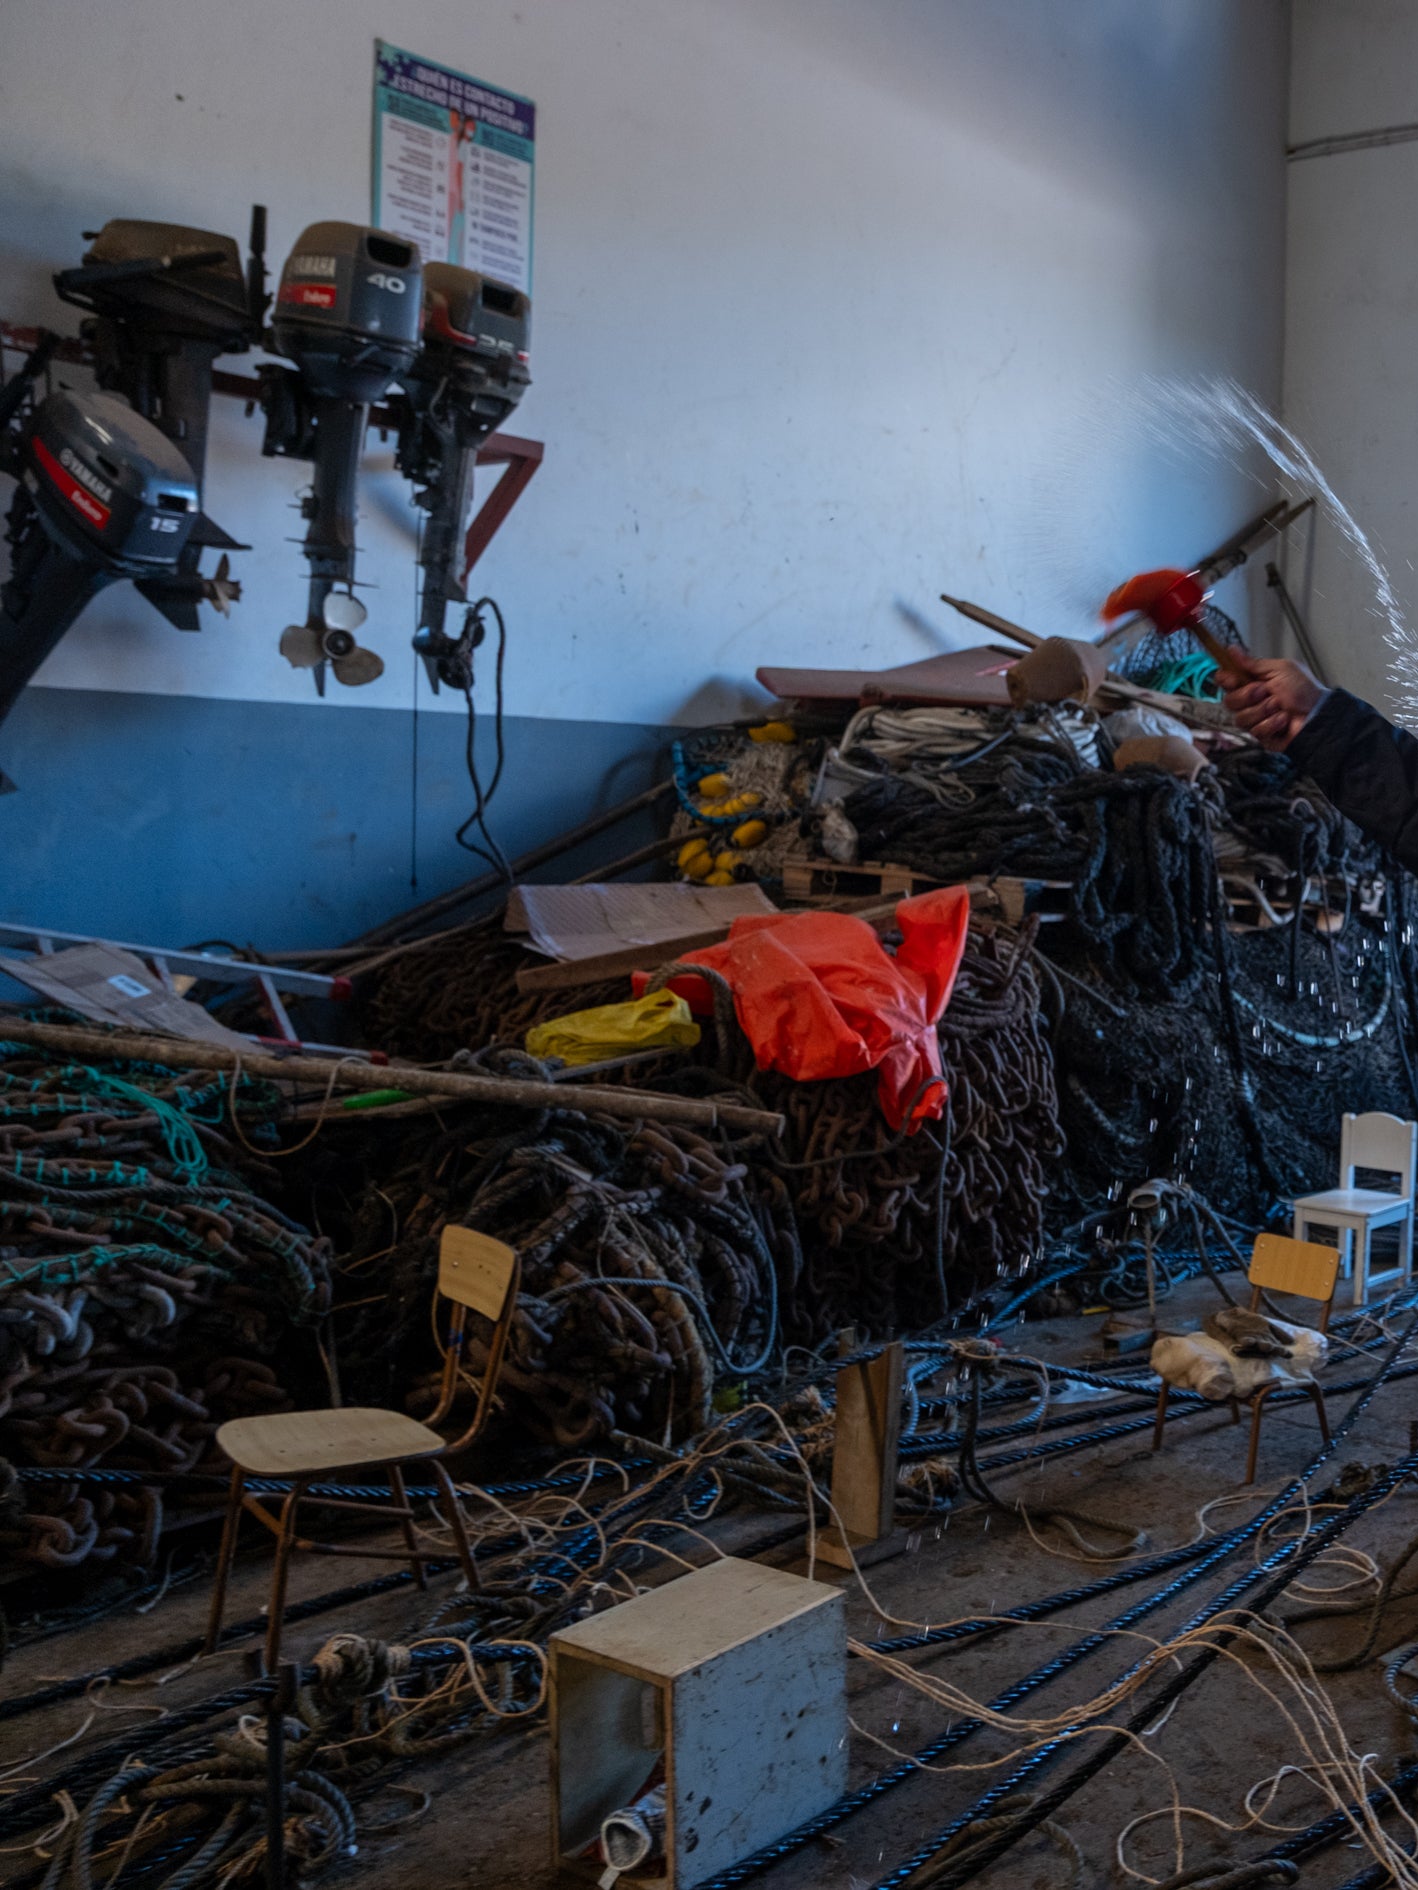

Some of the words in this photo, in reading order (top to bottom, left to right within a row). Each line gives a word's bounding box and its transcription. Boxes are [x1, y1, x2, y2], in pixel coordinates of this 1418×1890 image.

[367, 273, 406, 294] 40
[70, 457, 112, 502] YAMAHA
[150, 516, 180, 534] 15
